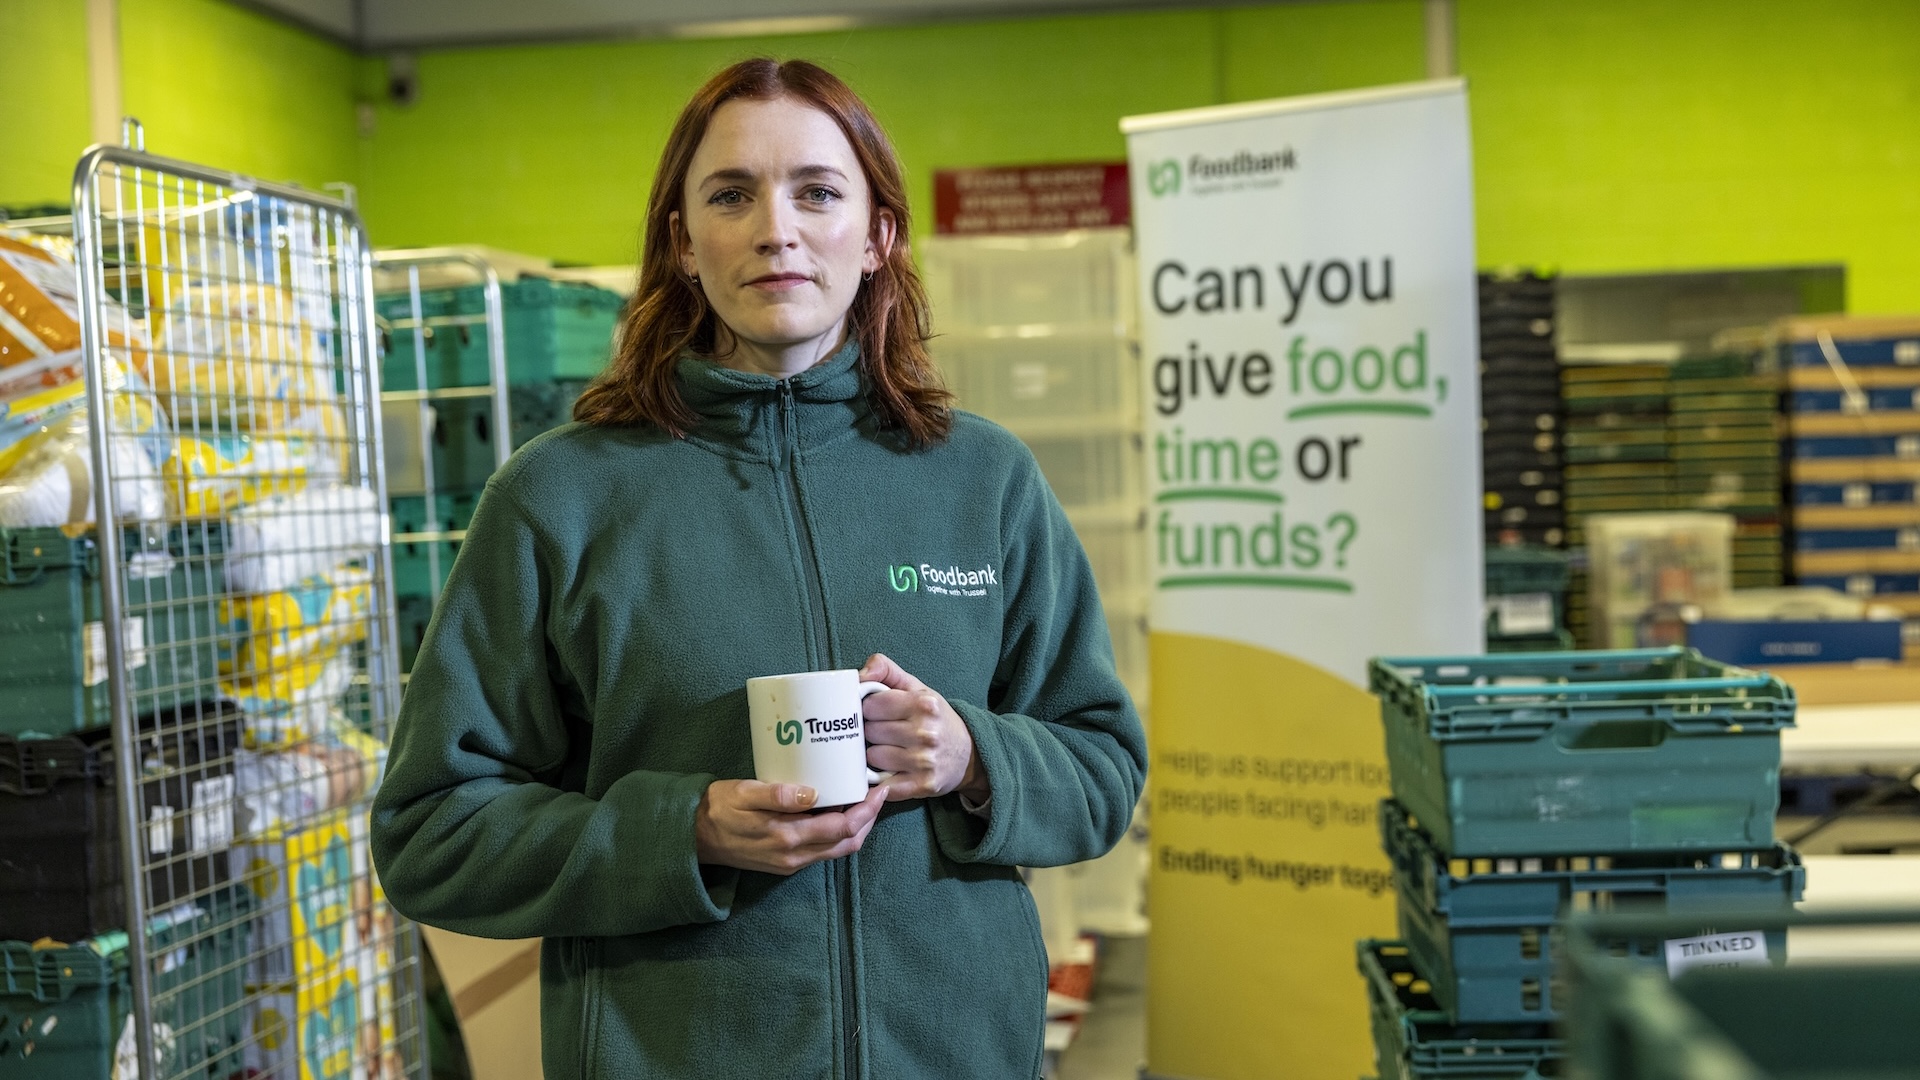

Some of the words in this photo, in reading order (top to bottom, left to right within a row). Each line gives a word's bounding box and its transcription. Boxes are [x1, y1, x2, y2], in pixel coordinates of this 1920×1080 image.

[1188, 147, 1296, 177] Foodbank
[1152, 261, 1264, 315] Can
[1279, 256, 1394, 326] you
[1155, 341, 1274, 417] give
[1287, 330, 1449, 402] food,
[1156, 426, 1282, 483] time
[1295, 435, 1363, 482] or
[1157, 509, 1358, 568] funds?
[920, 563, 998, 586] Foodbank
[948, 588, 961, 596] with
[804, 713, 859, 734] Trussell
[829, 733, 845, 741] hunger
[1219, 757, 1247, 778] us
[1252, 757, 1353, 786] support
[1160, 788, 1241, 816] people
[1245, 790, 1325, 829] facing
[1328, 799, 1379, 825] har
[1159, 847, 1242, 884] Ending
[1245, 854, 1334, 890] hunger
[1339, 864, 1397, 896] toge
[1680, 936, 1756, 957] TINNED
